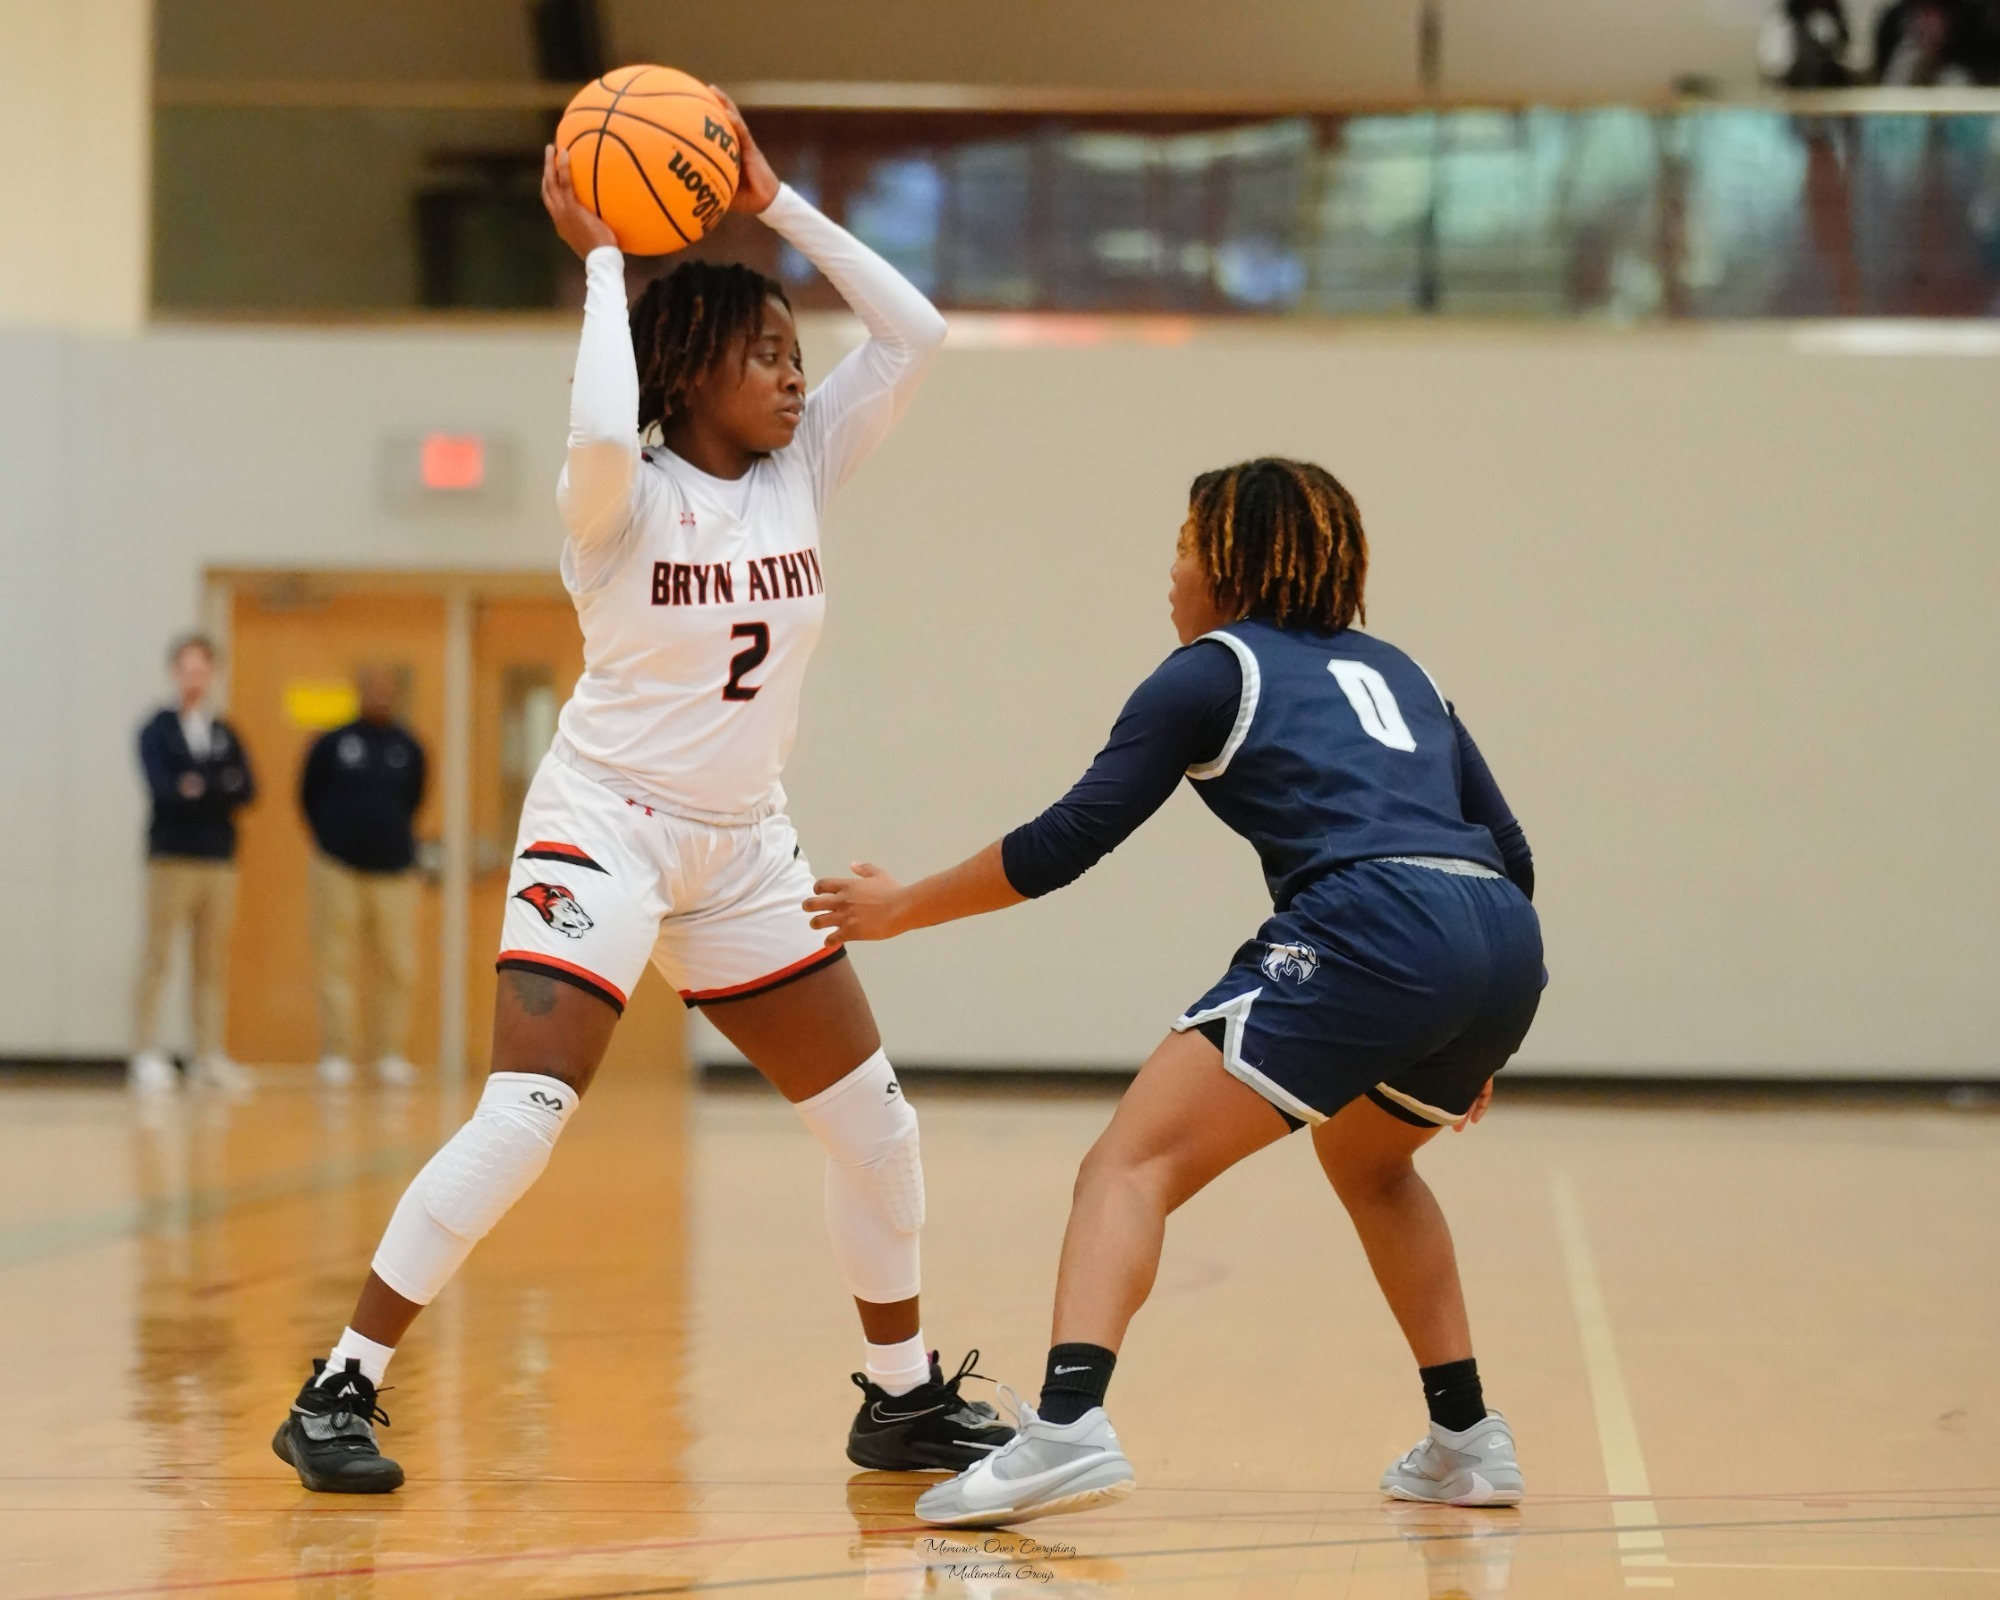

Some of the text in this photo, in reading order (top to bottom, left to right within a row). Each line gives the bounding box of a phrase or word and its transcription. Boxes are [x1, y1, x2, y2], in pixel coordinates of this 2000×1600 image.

[703, 115, 740, 170] CAA
[651, 546, 824, 606] BRYN ATHYN
[721, 621, 771, 702] 2
[1326, 659, 1418, 753] 0
